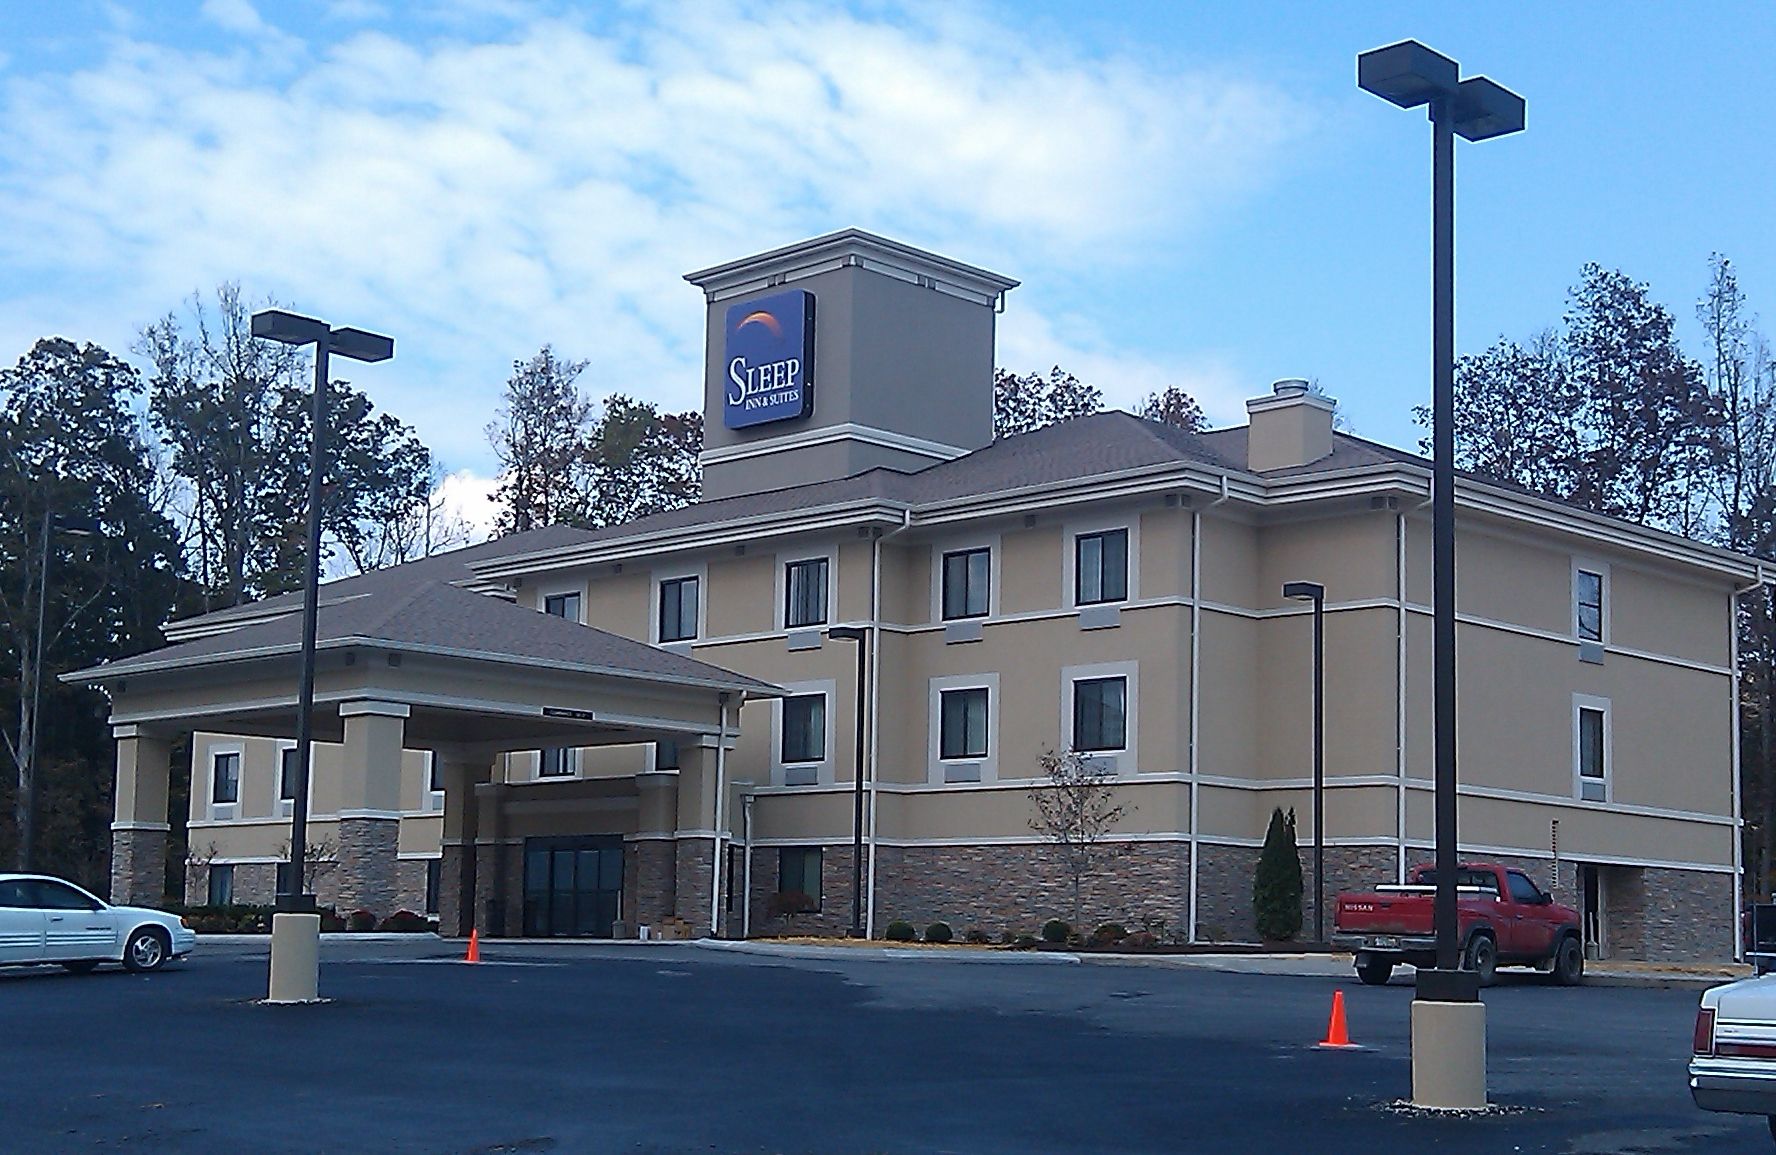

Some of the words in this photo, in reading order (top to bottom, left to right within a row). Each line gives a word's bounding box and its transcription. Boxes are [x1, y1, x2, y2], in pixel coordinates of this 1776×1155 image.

[729, 357, 800, 405] SLEEP
[745, 397, 761, 410] INN
[770, 389, 799, 406] SUITES
[1344, 903, 1374, 912] NISSAN
